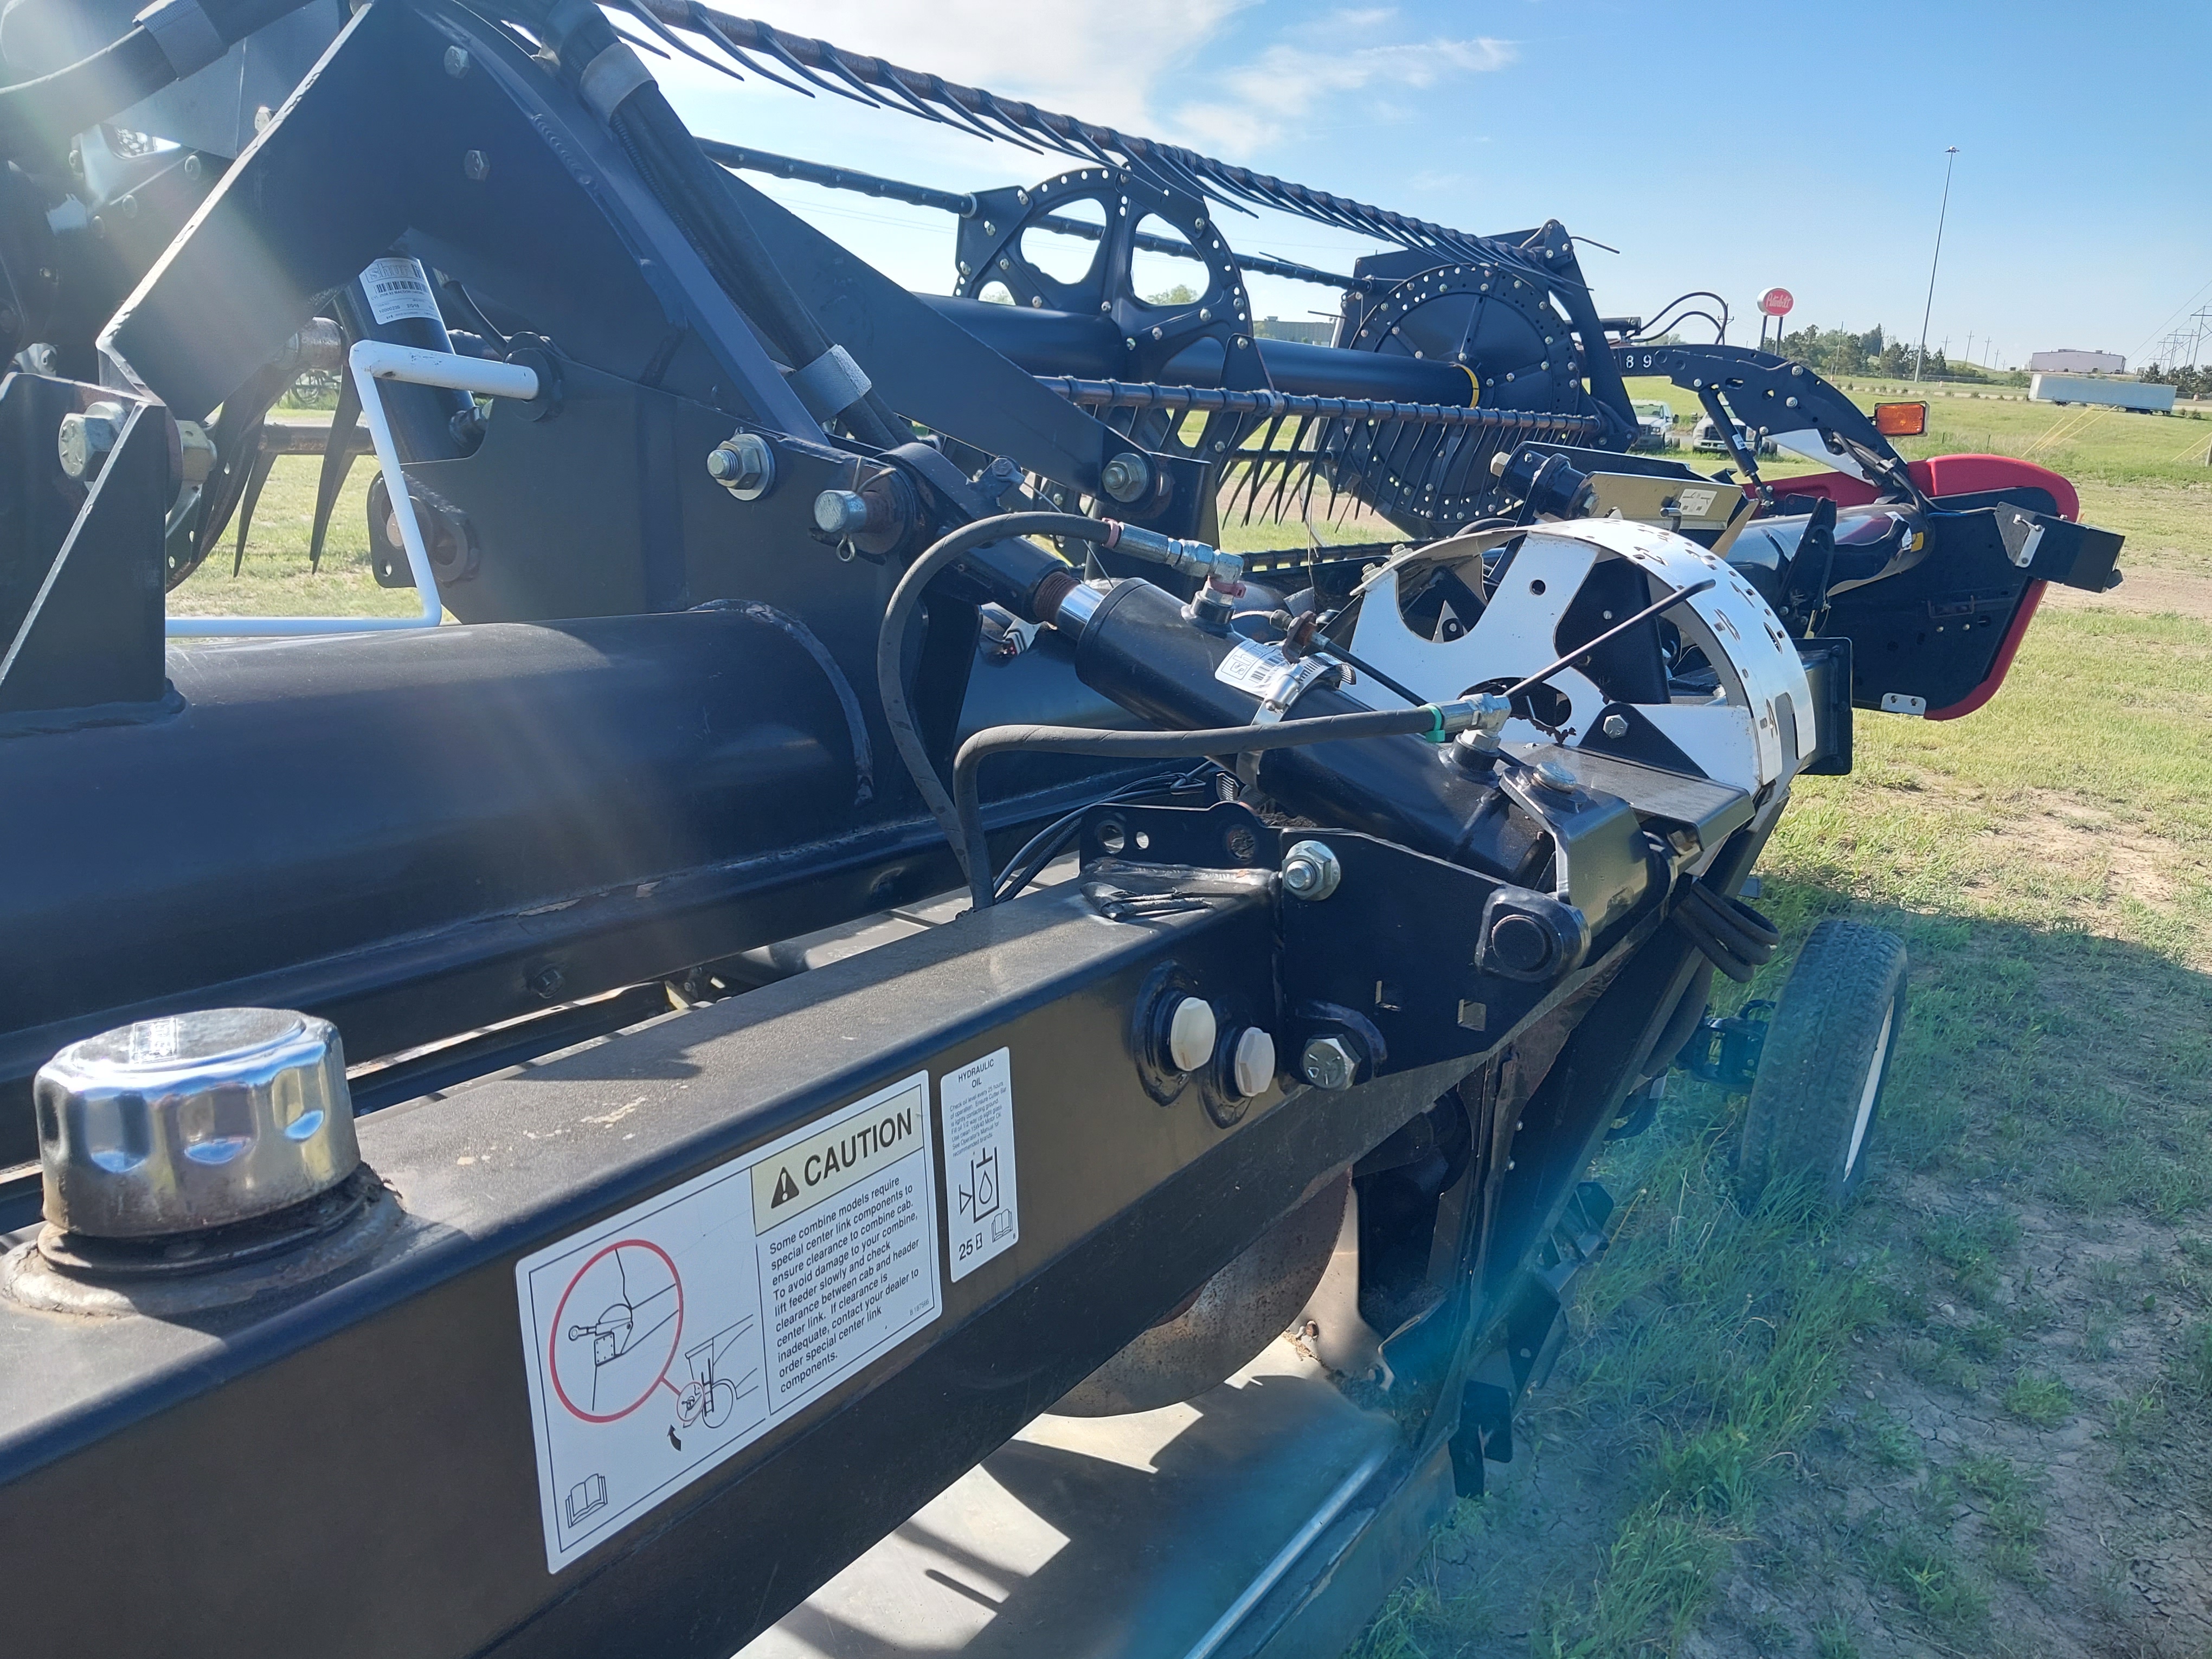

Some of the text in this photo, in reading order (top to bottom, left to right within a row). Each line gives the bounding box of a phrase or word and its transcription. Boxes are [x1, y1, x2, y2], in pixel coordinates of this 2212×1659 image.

[1766, 293, 1791, 308] Peterbilt
[1643, 355, 1652, 368] 9
[959, 1059, 994, 1083] HYDRAULIC
[971, 1077, 982, 1088] OIL
[804, 1107, 912, 1186] CAUTION
[769, 1177, 899, 1254] Some combine models require
[771, 1185, 912, 1271] special center link components to
[772, 1198, 913, 1285] ensure clearance to combine cab.
[959, 1239, 973, 1262] 25
[773, 1212, 917, 1301] To avoid damage to your combine,
[774, 1240, 891, 1317] lift feeder slowly and check
[776, 1238, 919, 1332] clearance between cab and header
[777, 1272, 888, 1347] center link. If clearance is
[777, 1268, 918, 1363] inadequate, contact your dealer to
[779, 1305, 882, 1378] order special center link
[780, 1352, 837, 1393] components.
